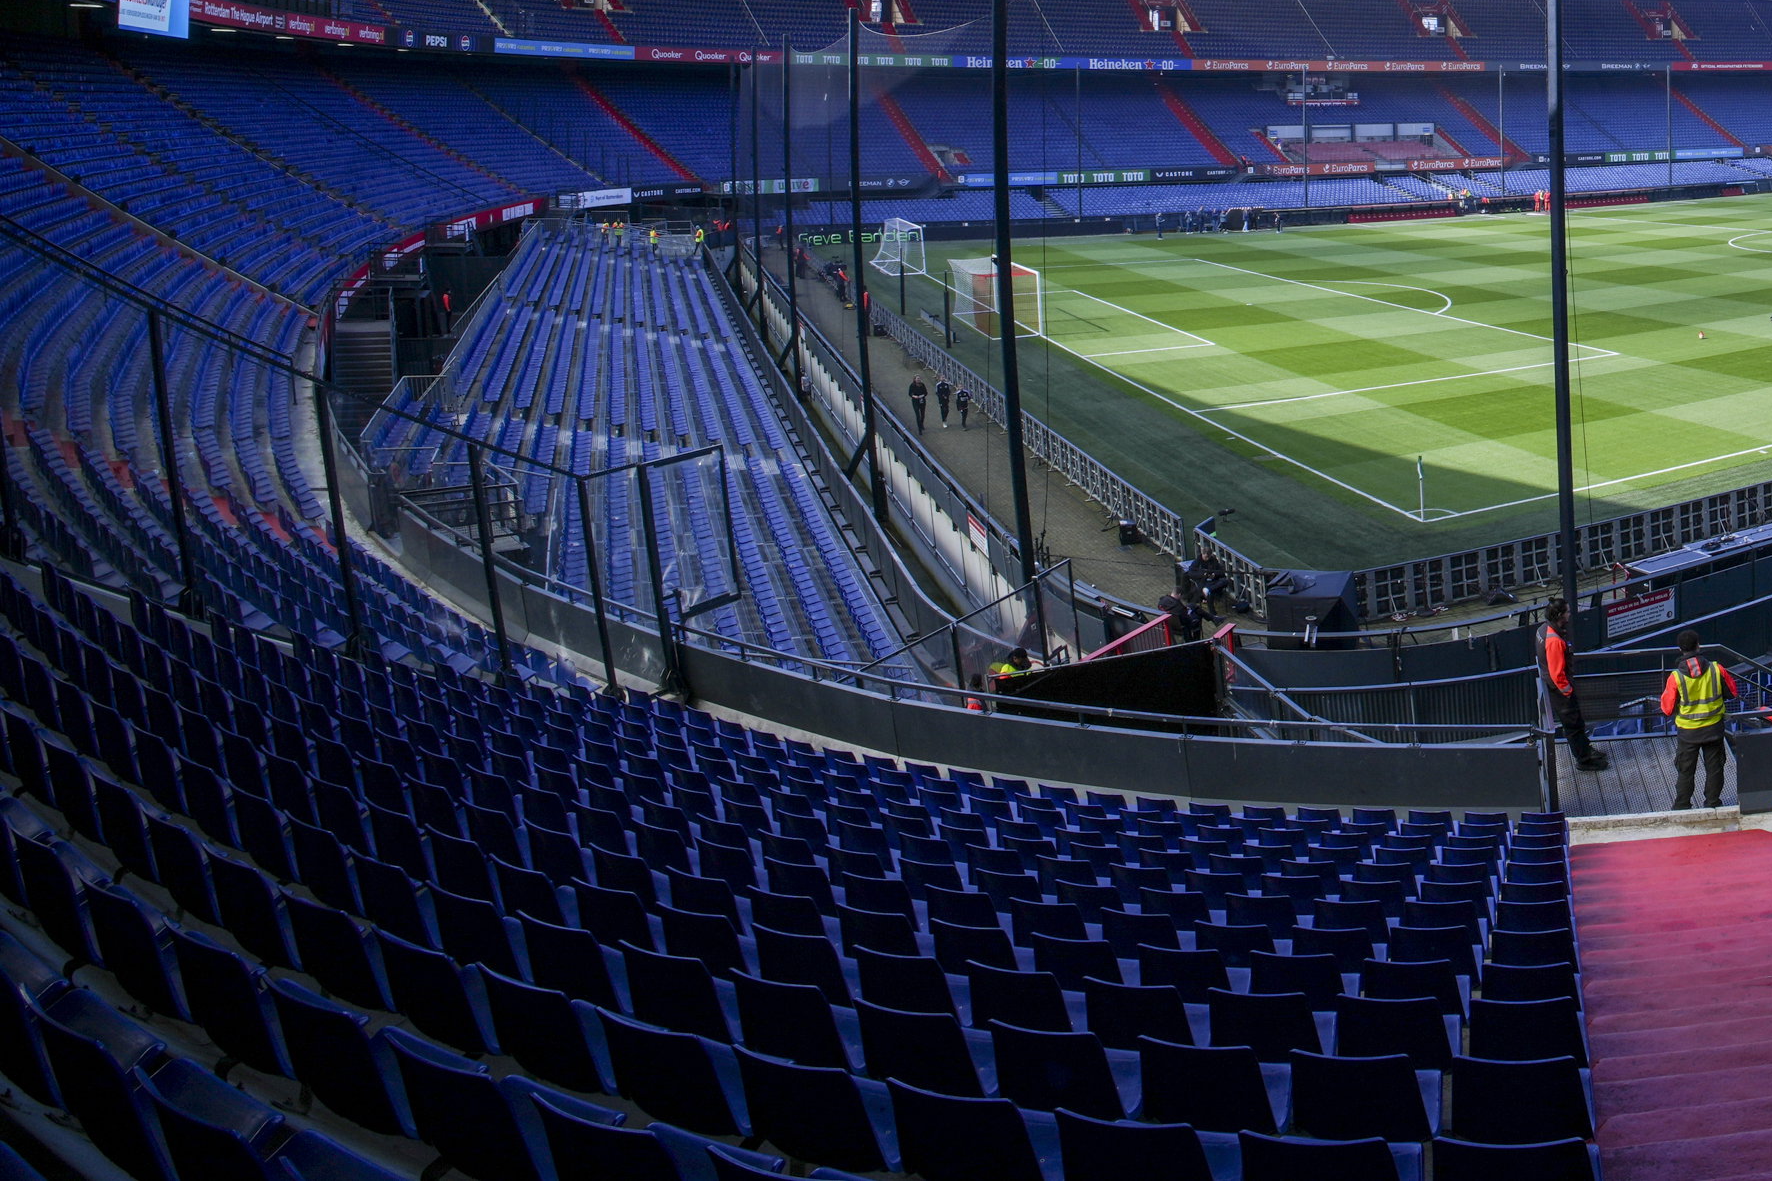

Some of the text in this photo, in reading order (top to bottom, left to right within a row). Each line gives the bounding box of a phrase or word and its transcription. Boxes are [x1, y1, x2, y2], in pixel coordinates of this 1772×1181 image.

[204, 1, 231, 19] Rotterdam
[231, 6, 240, 20] The
[240, 9, 255, 26] Hague
[255, 10, 273, 28] Airport
[426, 34, 447, 47] PEPSI
[651, 48, 683, 60] Quooker
[695, 49, 726, 61] Quooker
[796, 55, 813, 64] TOTO
[823, 55, 840, 64] TOTO
[876, 56, 894, 65] TOTO
[905, 57, 921, 66] TOTO
[931, 57, 948, 66] TOTO
[1089, 58, 1142, 70] Heineken
[1212, 61, 1480, 71] EuroParcs EuroParcs EuroParcs EuroParcs EuroParcs
[1609, 154, 1626, 162] TOTO
[1632, 153, 1649, 161] TOTO
[1331, 162, 1368, 173] EuroParcs
[1418, 160, 1454, 170] EuroParcs
[1471, 159, 1501, 168] EuroParc
[1092, 172, 1114, 183] TOTO
[1122, 171, 1144, 182] TOTO
[640, 189, 663, 197] CASTORE
[798, 232, 842, 245] Greve
